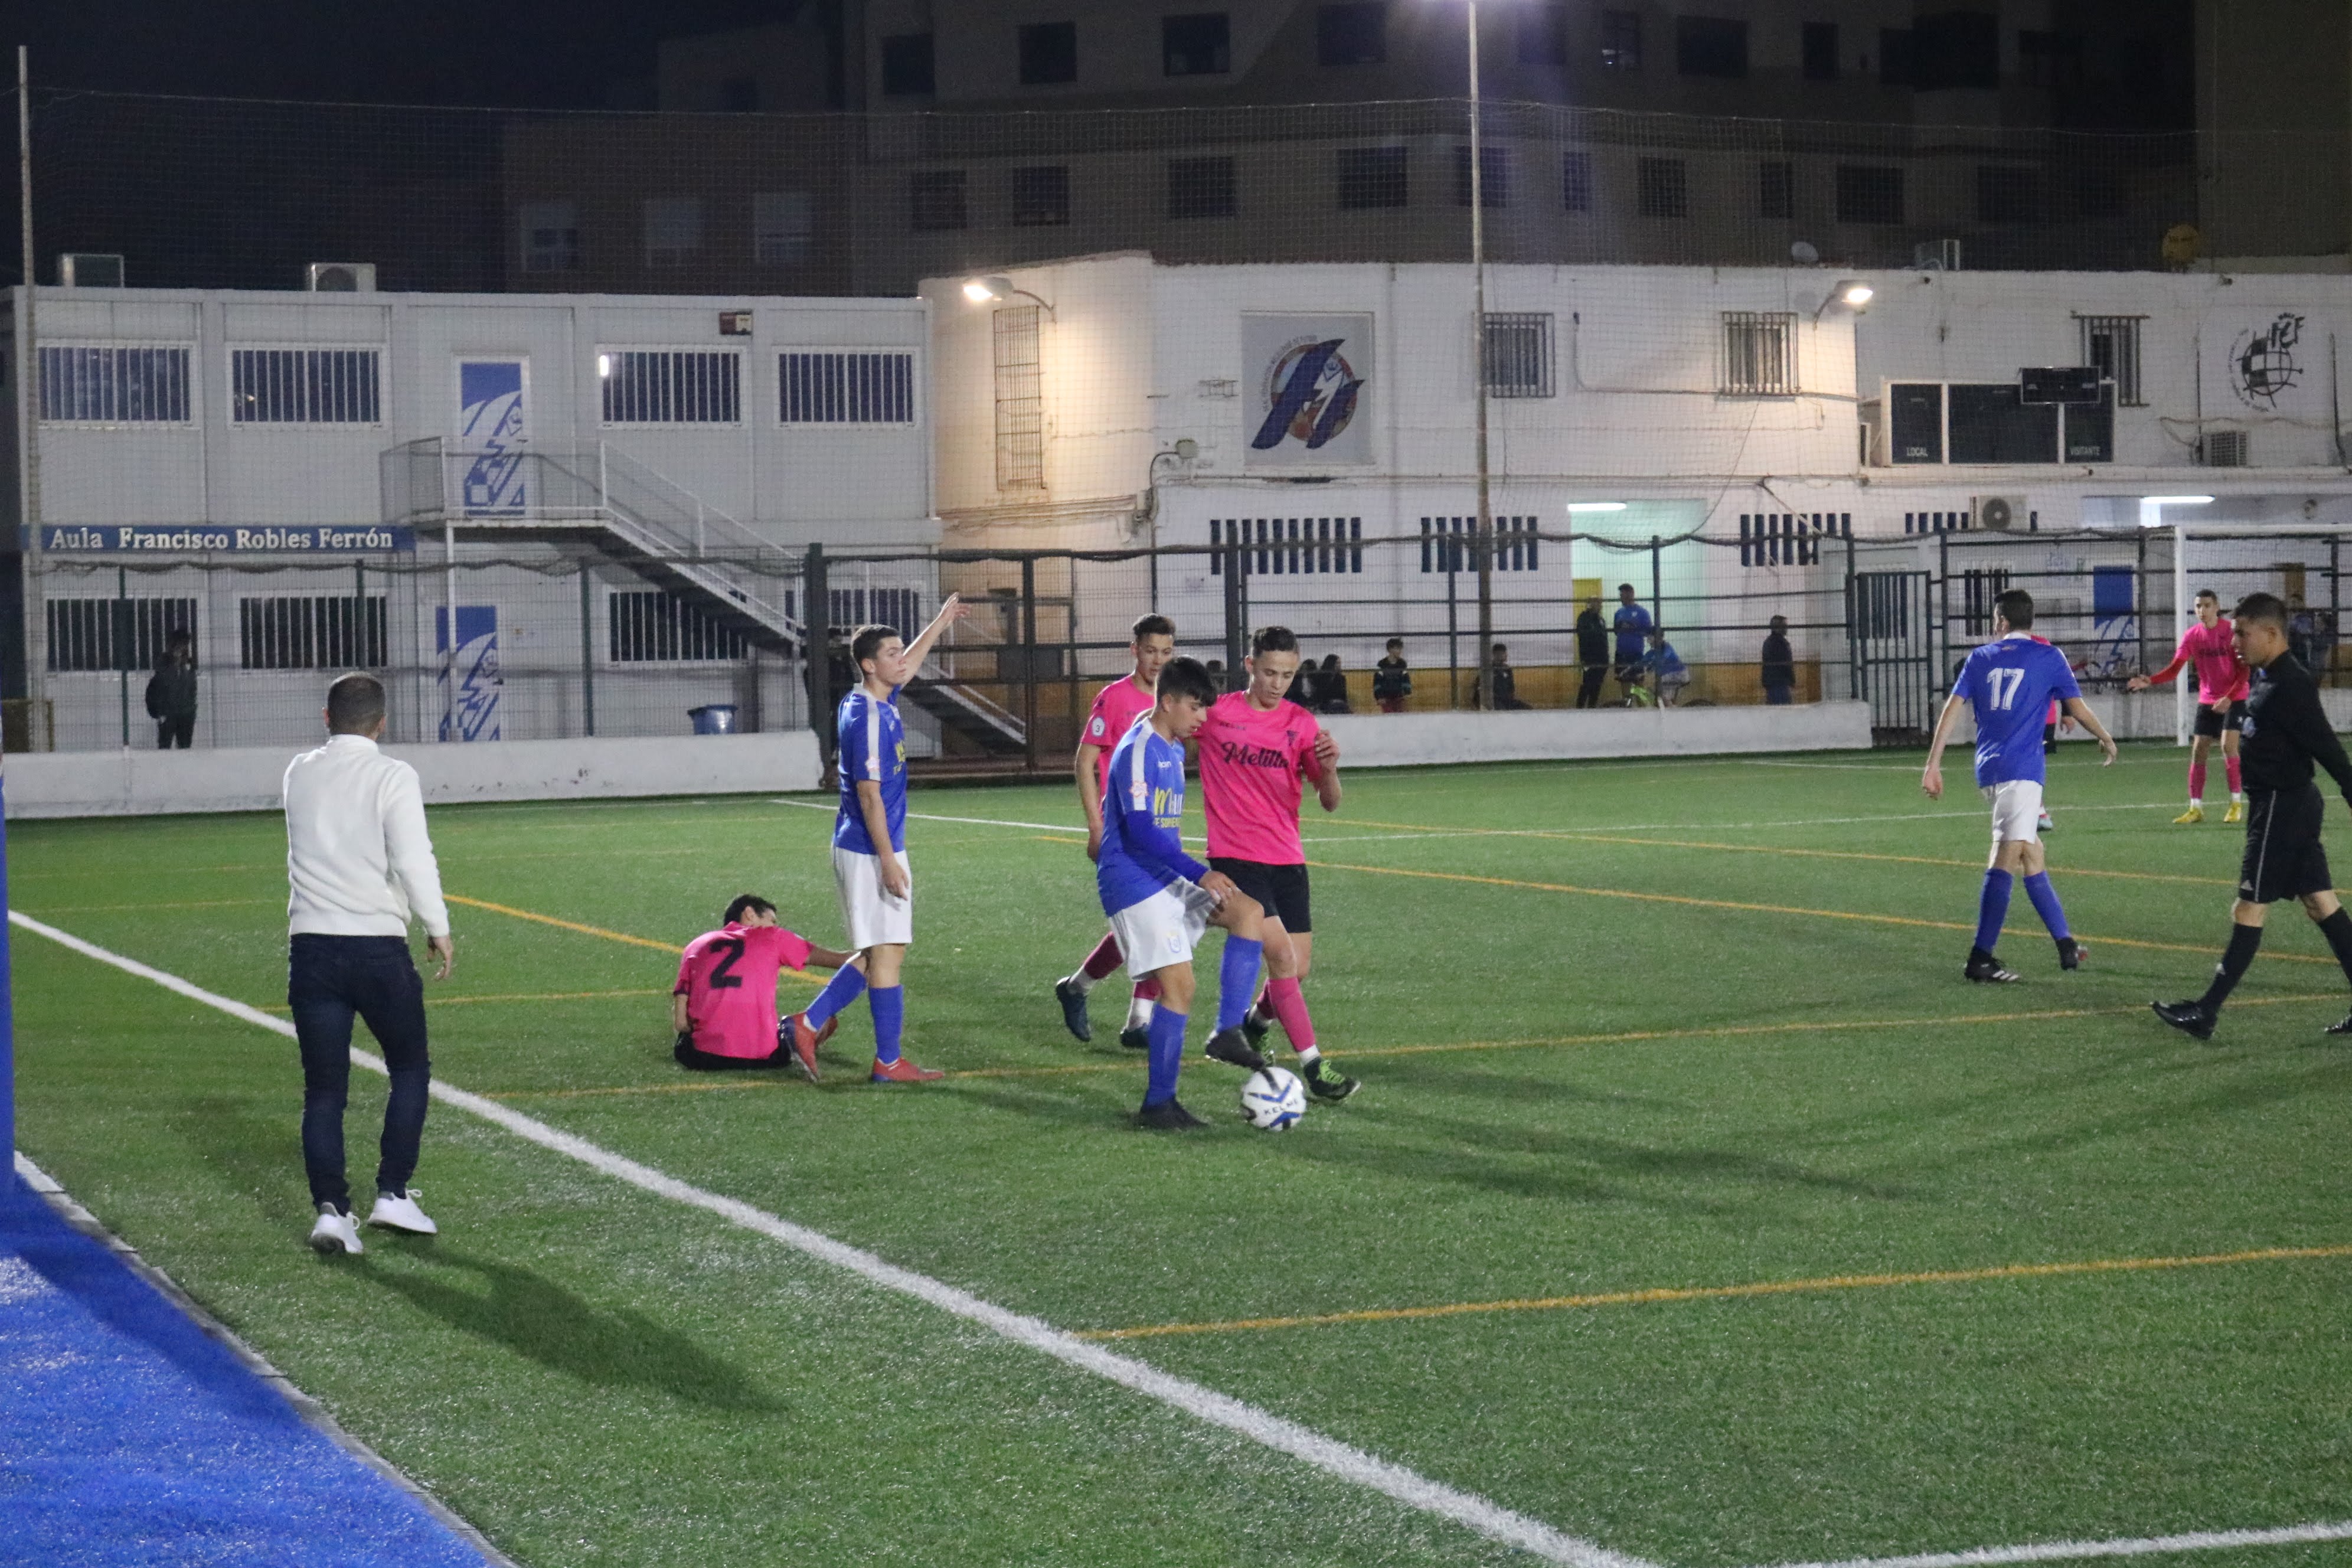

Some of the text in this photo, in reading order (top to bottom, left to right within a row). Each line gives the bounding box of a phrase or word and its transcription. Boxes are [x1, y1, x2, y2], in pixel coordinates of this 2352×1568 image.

[1906, 447, 1928, 458] LOCAL
[2069, 445, 2101, 456] VISITANTE
[50, 527, 393, 549] Aula Francisco Robles Ferrón
[1987, 667, 2025, 710] 17
[710, 939, 745, 988] 2
